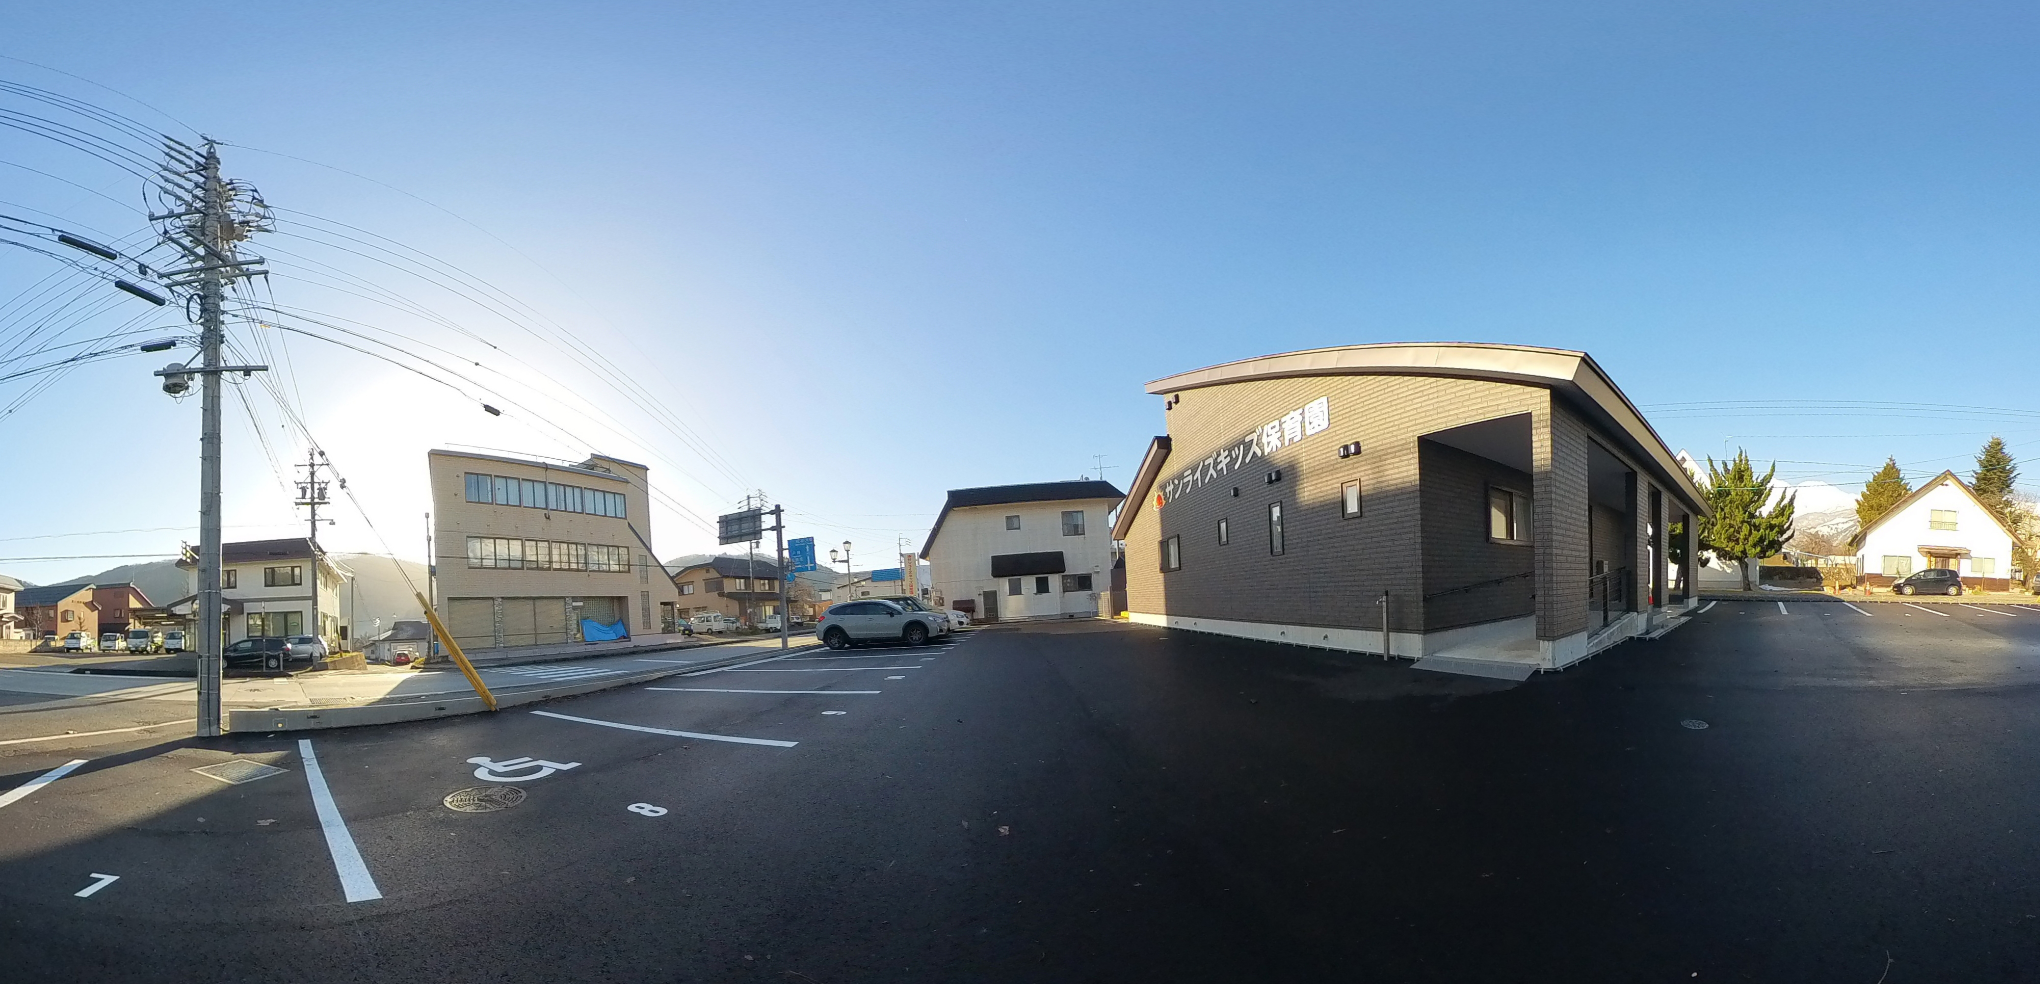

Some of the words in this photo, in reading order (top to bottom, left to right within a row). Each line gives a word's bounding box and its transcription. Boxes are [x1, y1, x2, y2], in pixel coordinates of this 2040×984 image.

[1165, 396, 1330, 503] サンライズキッズ保育園
[627, 802, 668, 817] 8
[73, 872, 121, 898] 7
